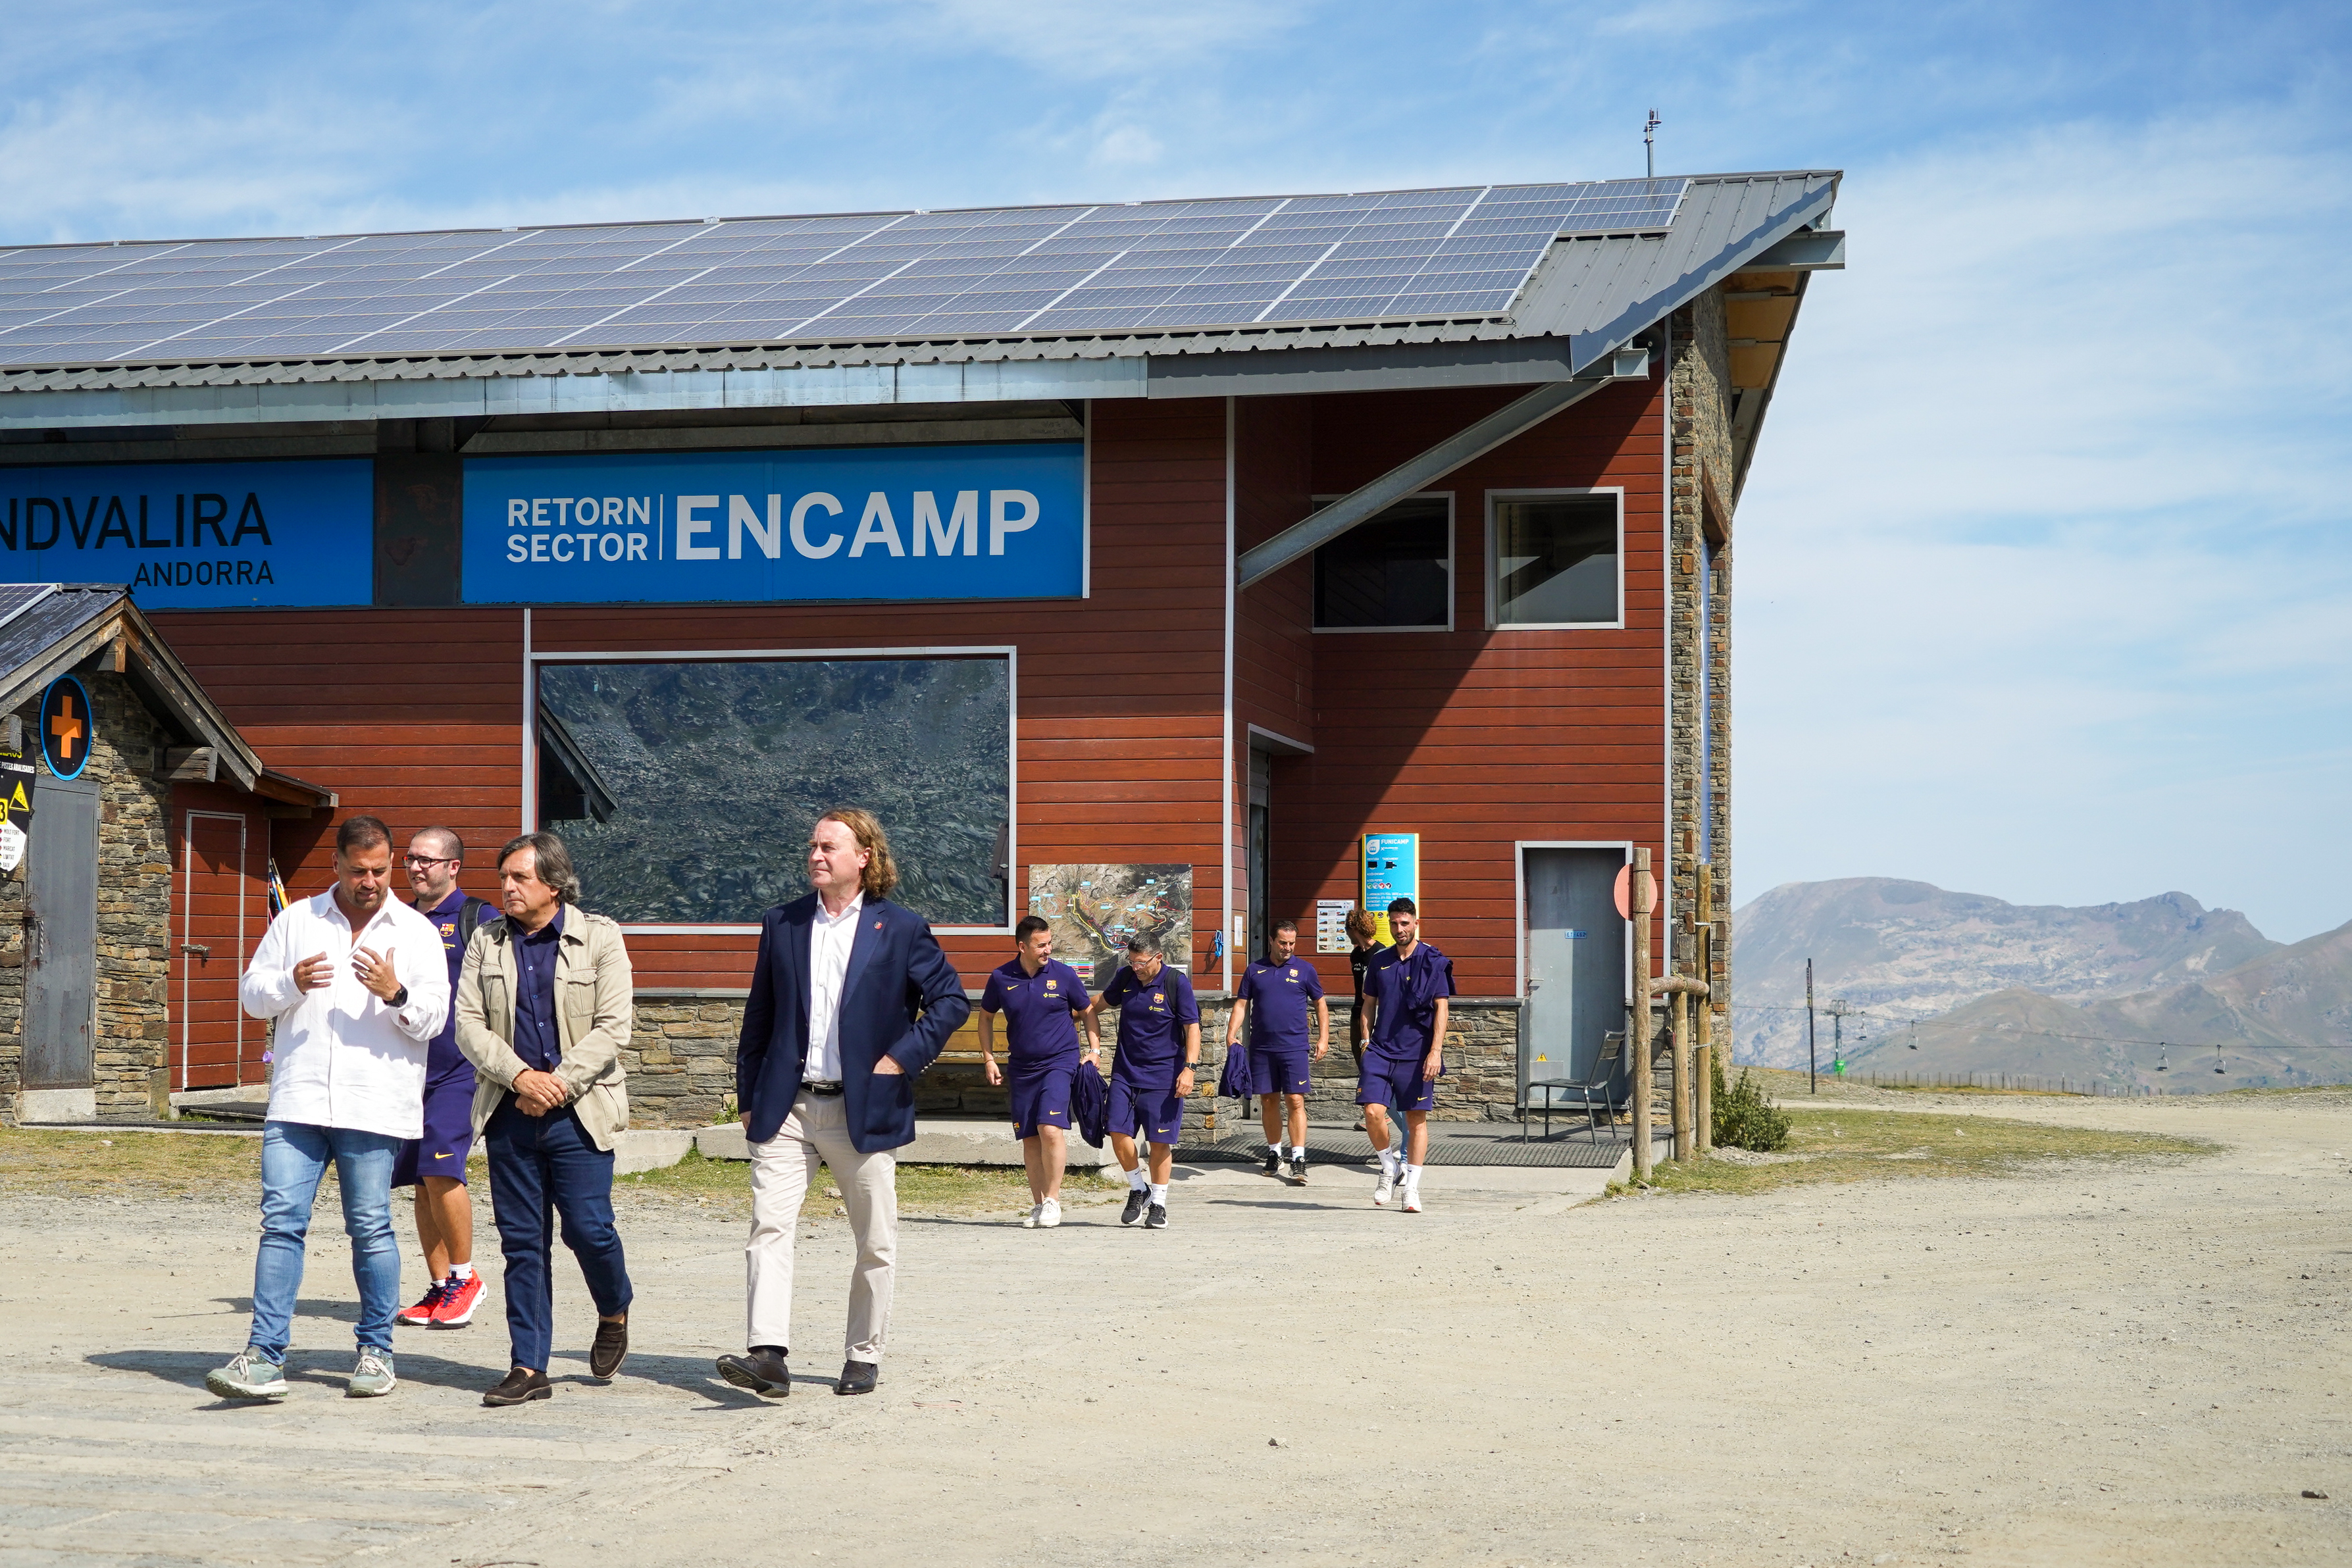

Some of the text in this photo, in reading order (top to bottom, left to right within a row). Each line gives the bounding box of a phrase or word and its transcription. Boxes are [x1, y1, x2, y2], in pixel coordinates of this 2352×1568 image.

[508, 496, 651, 527] RETORN
[675, 489, 1040, 561] ENCAMP
[506, 532, 649, 563] SECTOR
[134, 560, 274, 587] ANDORRA
